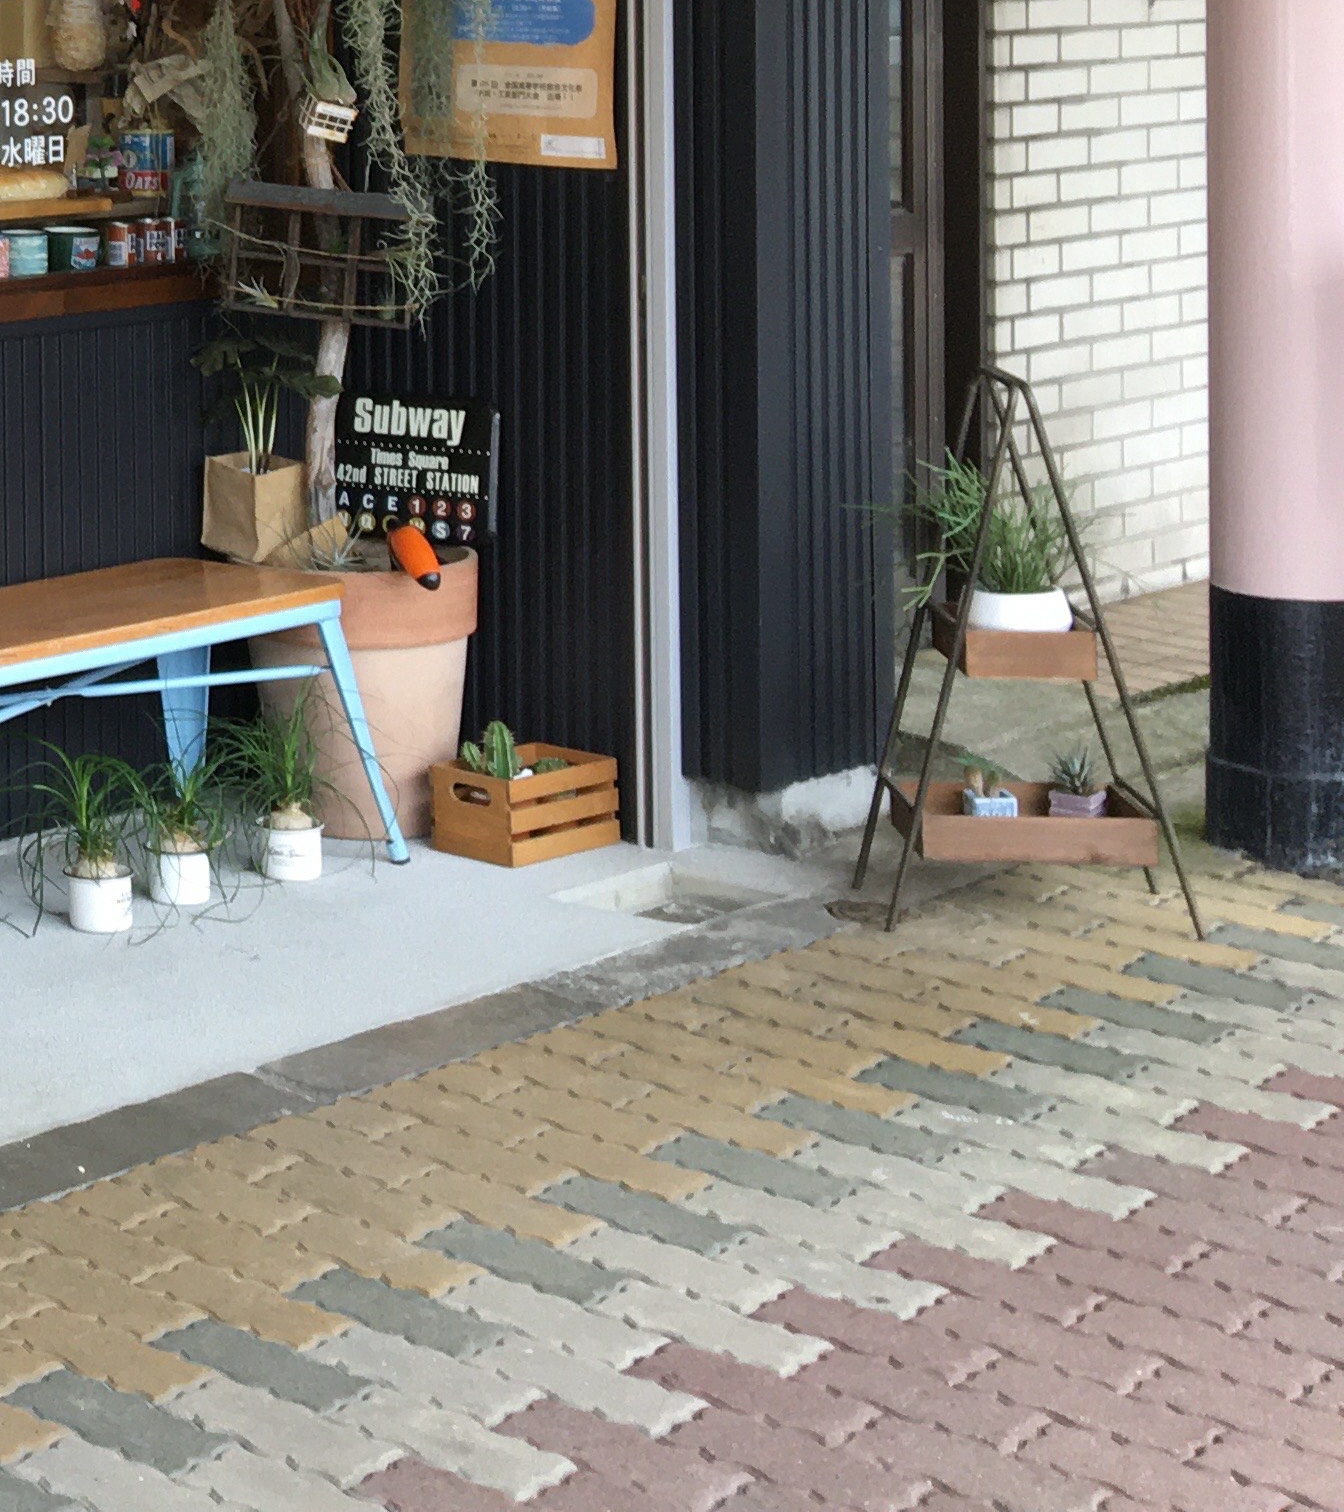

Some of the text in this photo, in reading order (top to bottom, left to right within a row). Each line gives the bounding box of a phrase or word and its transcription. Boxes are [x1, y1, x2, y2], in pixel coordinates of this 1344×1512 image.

[354, 397, 466, 447] Subway
[371, 447, 449, 471] Times Square
[337, 463, 480, 495] 42nd STREET STATION
[338, 490, 472, 520] A C E 1 2 3
[435, 522, 446, 539] S
[460, 525, 471, 541] 7
